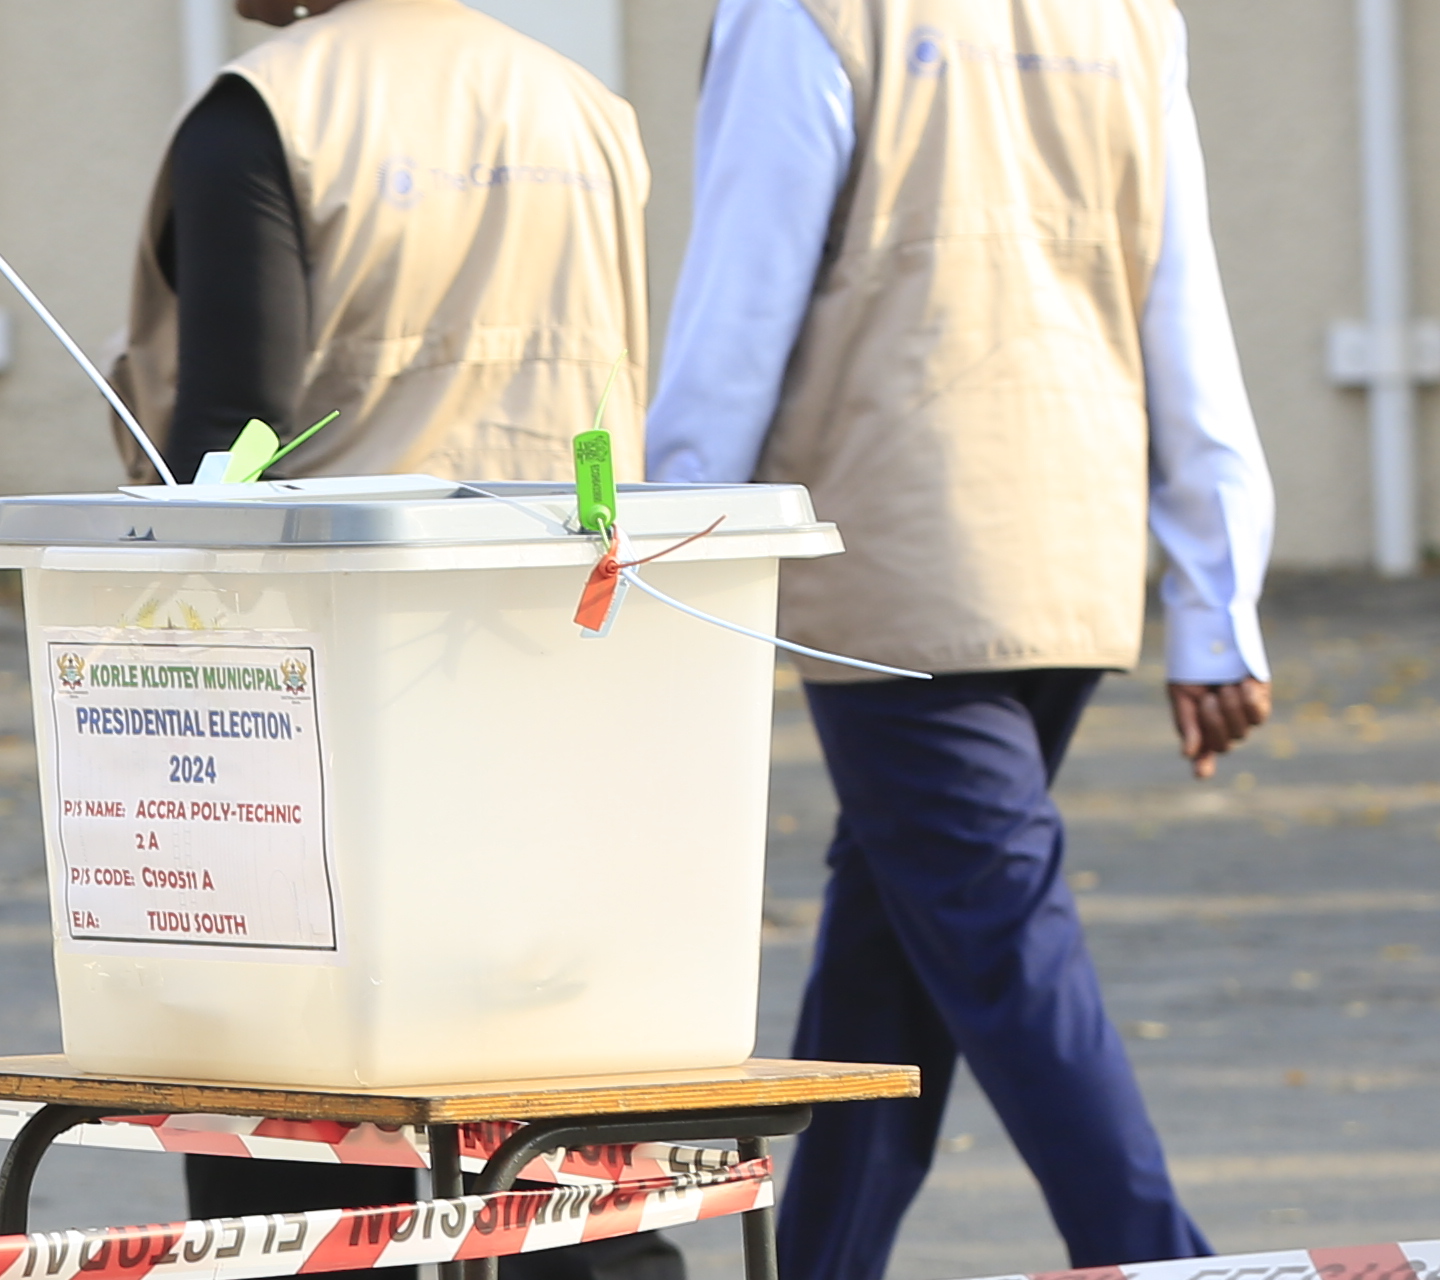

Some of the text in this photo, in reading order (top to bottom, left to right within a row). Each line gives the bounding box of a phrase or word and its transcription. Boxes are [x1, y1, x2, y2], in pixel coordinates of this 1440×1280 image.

[90, 664, 282, 692] KORLE KLOTTEY MUNICIPAL
[76, 707, 205, 738] PRESIDENTIAL
[208, 710, 293, 740] ELECTION
[169, 755, 216, 784] 2024
[64, 799, 302, 824] P/S NAME: ACCRA POLY-TECHNIC
[136, 832, 159, 851] 2 A
[71, 867, 215, 891] P/S CODE: C190511 A
[73, 910, 247, 935] E/A: TUDU SOUTH
